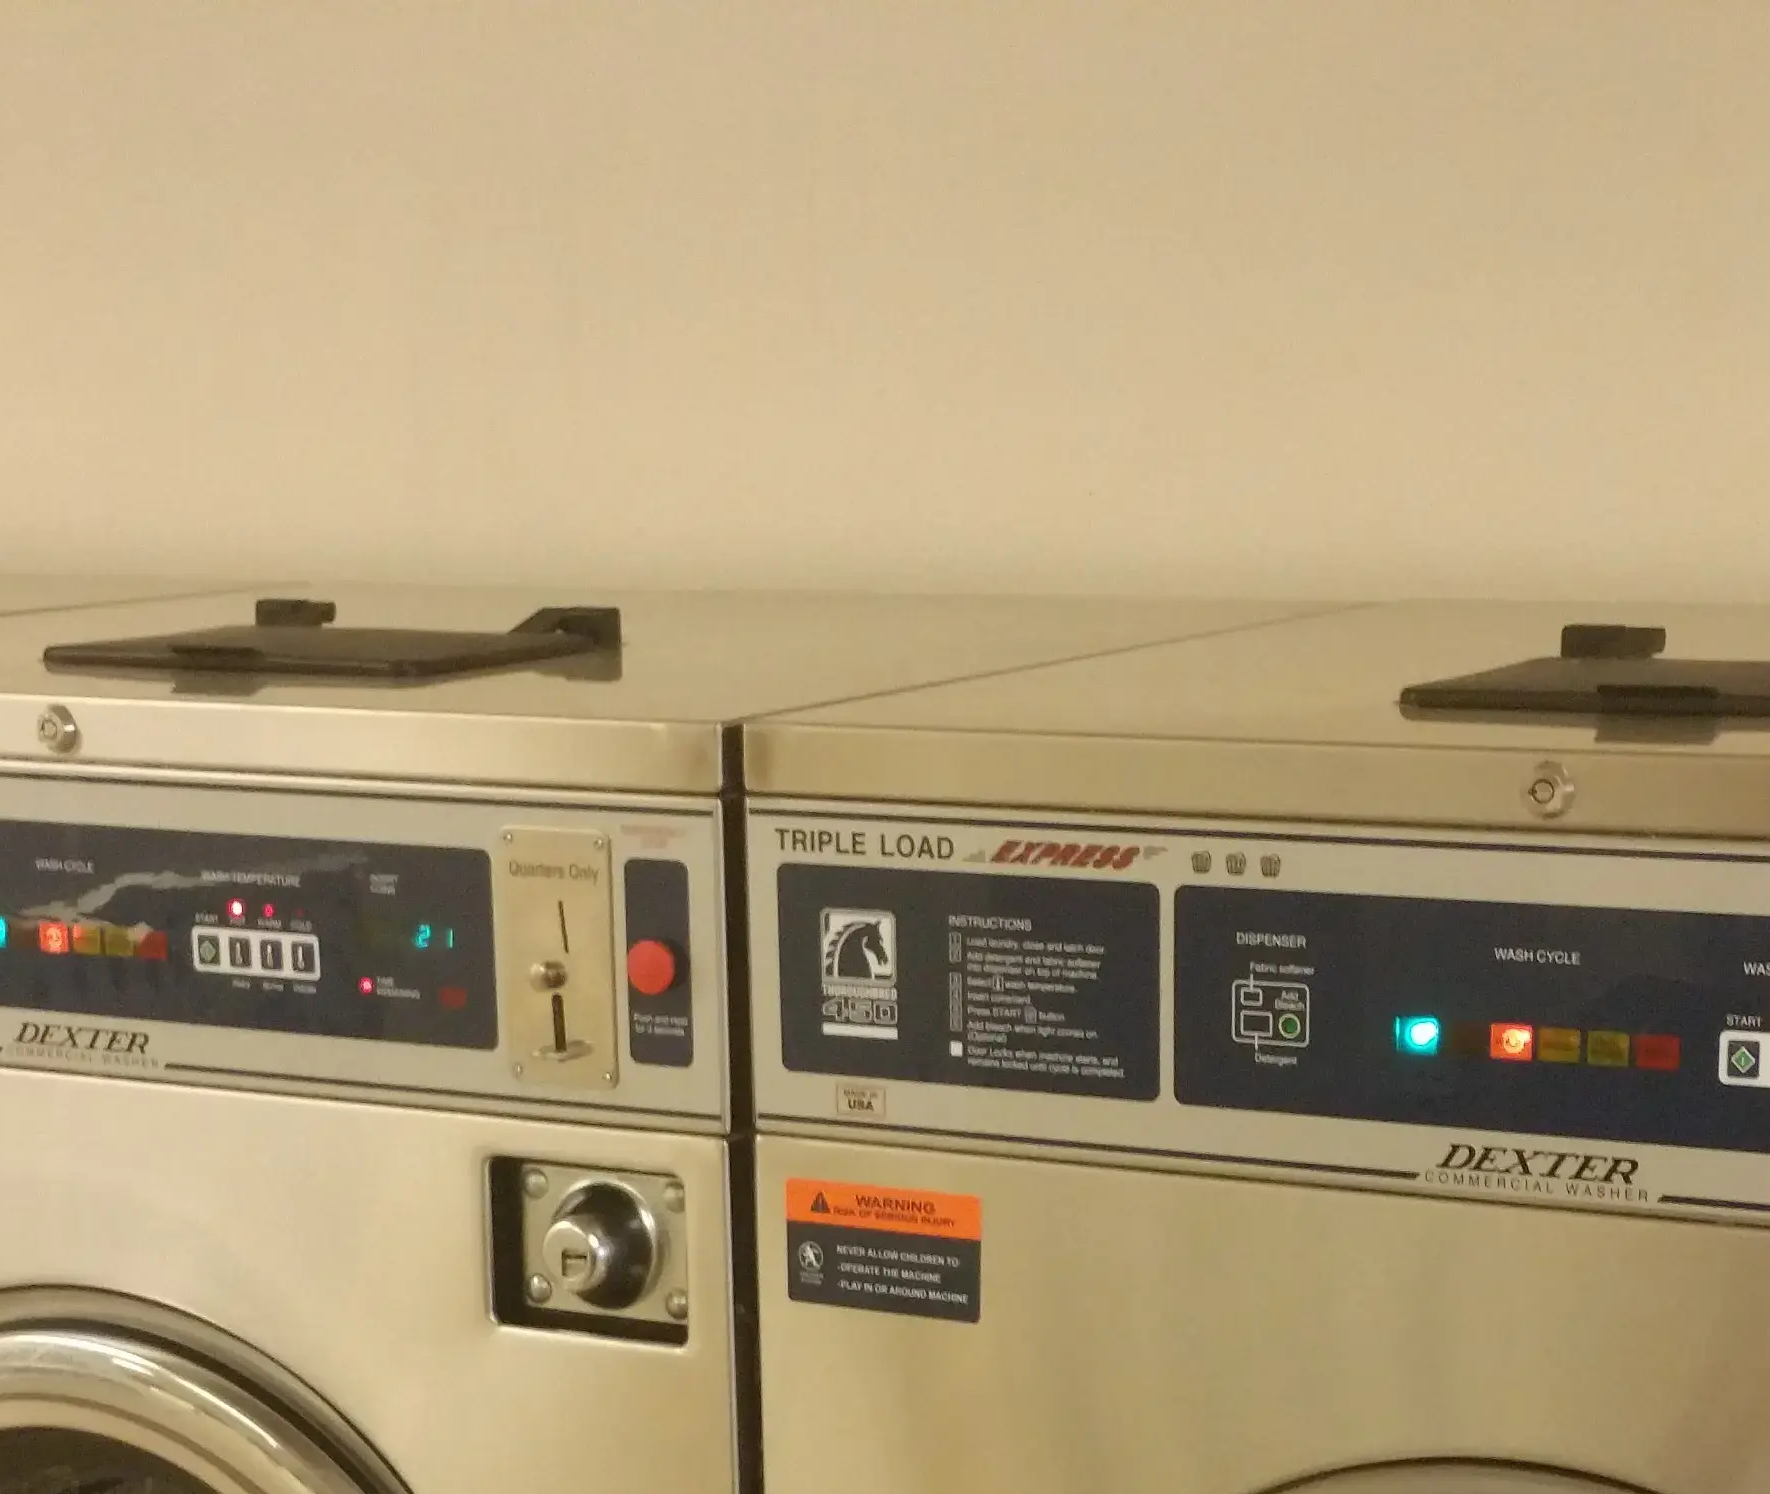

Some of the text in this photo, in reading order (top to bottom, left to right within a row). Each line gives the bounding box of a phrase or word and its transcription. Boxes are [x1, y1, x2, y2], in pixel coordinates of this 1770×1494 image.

[775, 827, 1141, 869] TRIPLE LOAD EXPRESS
[569, 864, 599, 884] Only
[1236, 931, 1307, 949] DISPENSER
[1494, 947, 1580, 965] WASH CYCLE
[1727, 1014, 1762, 1028] START
[16, 1021, 149, 1054] DEXTER
[1436, 1144, 1639, 1186] DEXTER
[1425, 1172, 1648, 1202] COMMERCIAL WASHER
[855, 1194, 936, 1214] WARNING
[836, 1244, 865, 1257] NEVER
[867, 1248, 898, 1260] ALLOW
[900, 1252, 944, 1266] CHILDREN
[883, 1267, 899, 1278] THE
[901, 1269, 941, 1284] MACHINE
[874, 1283, 889, 1295] OR
[890, 1285, 926, 1300] AROUND
[928, 1290, 969, 1305] MACHINE
